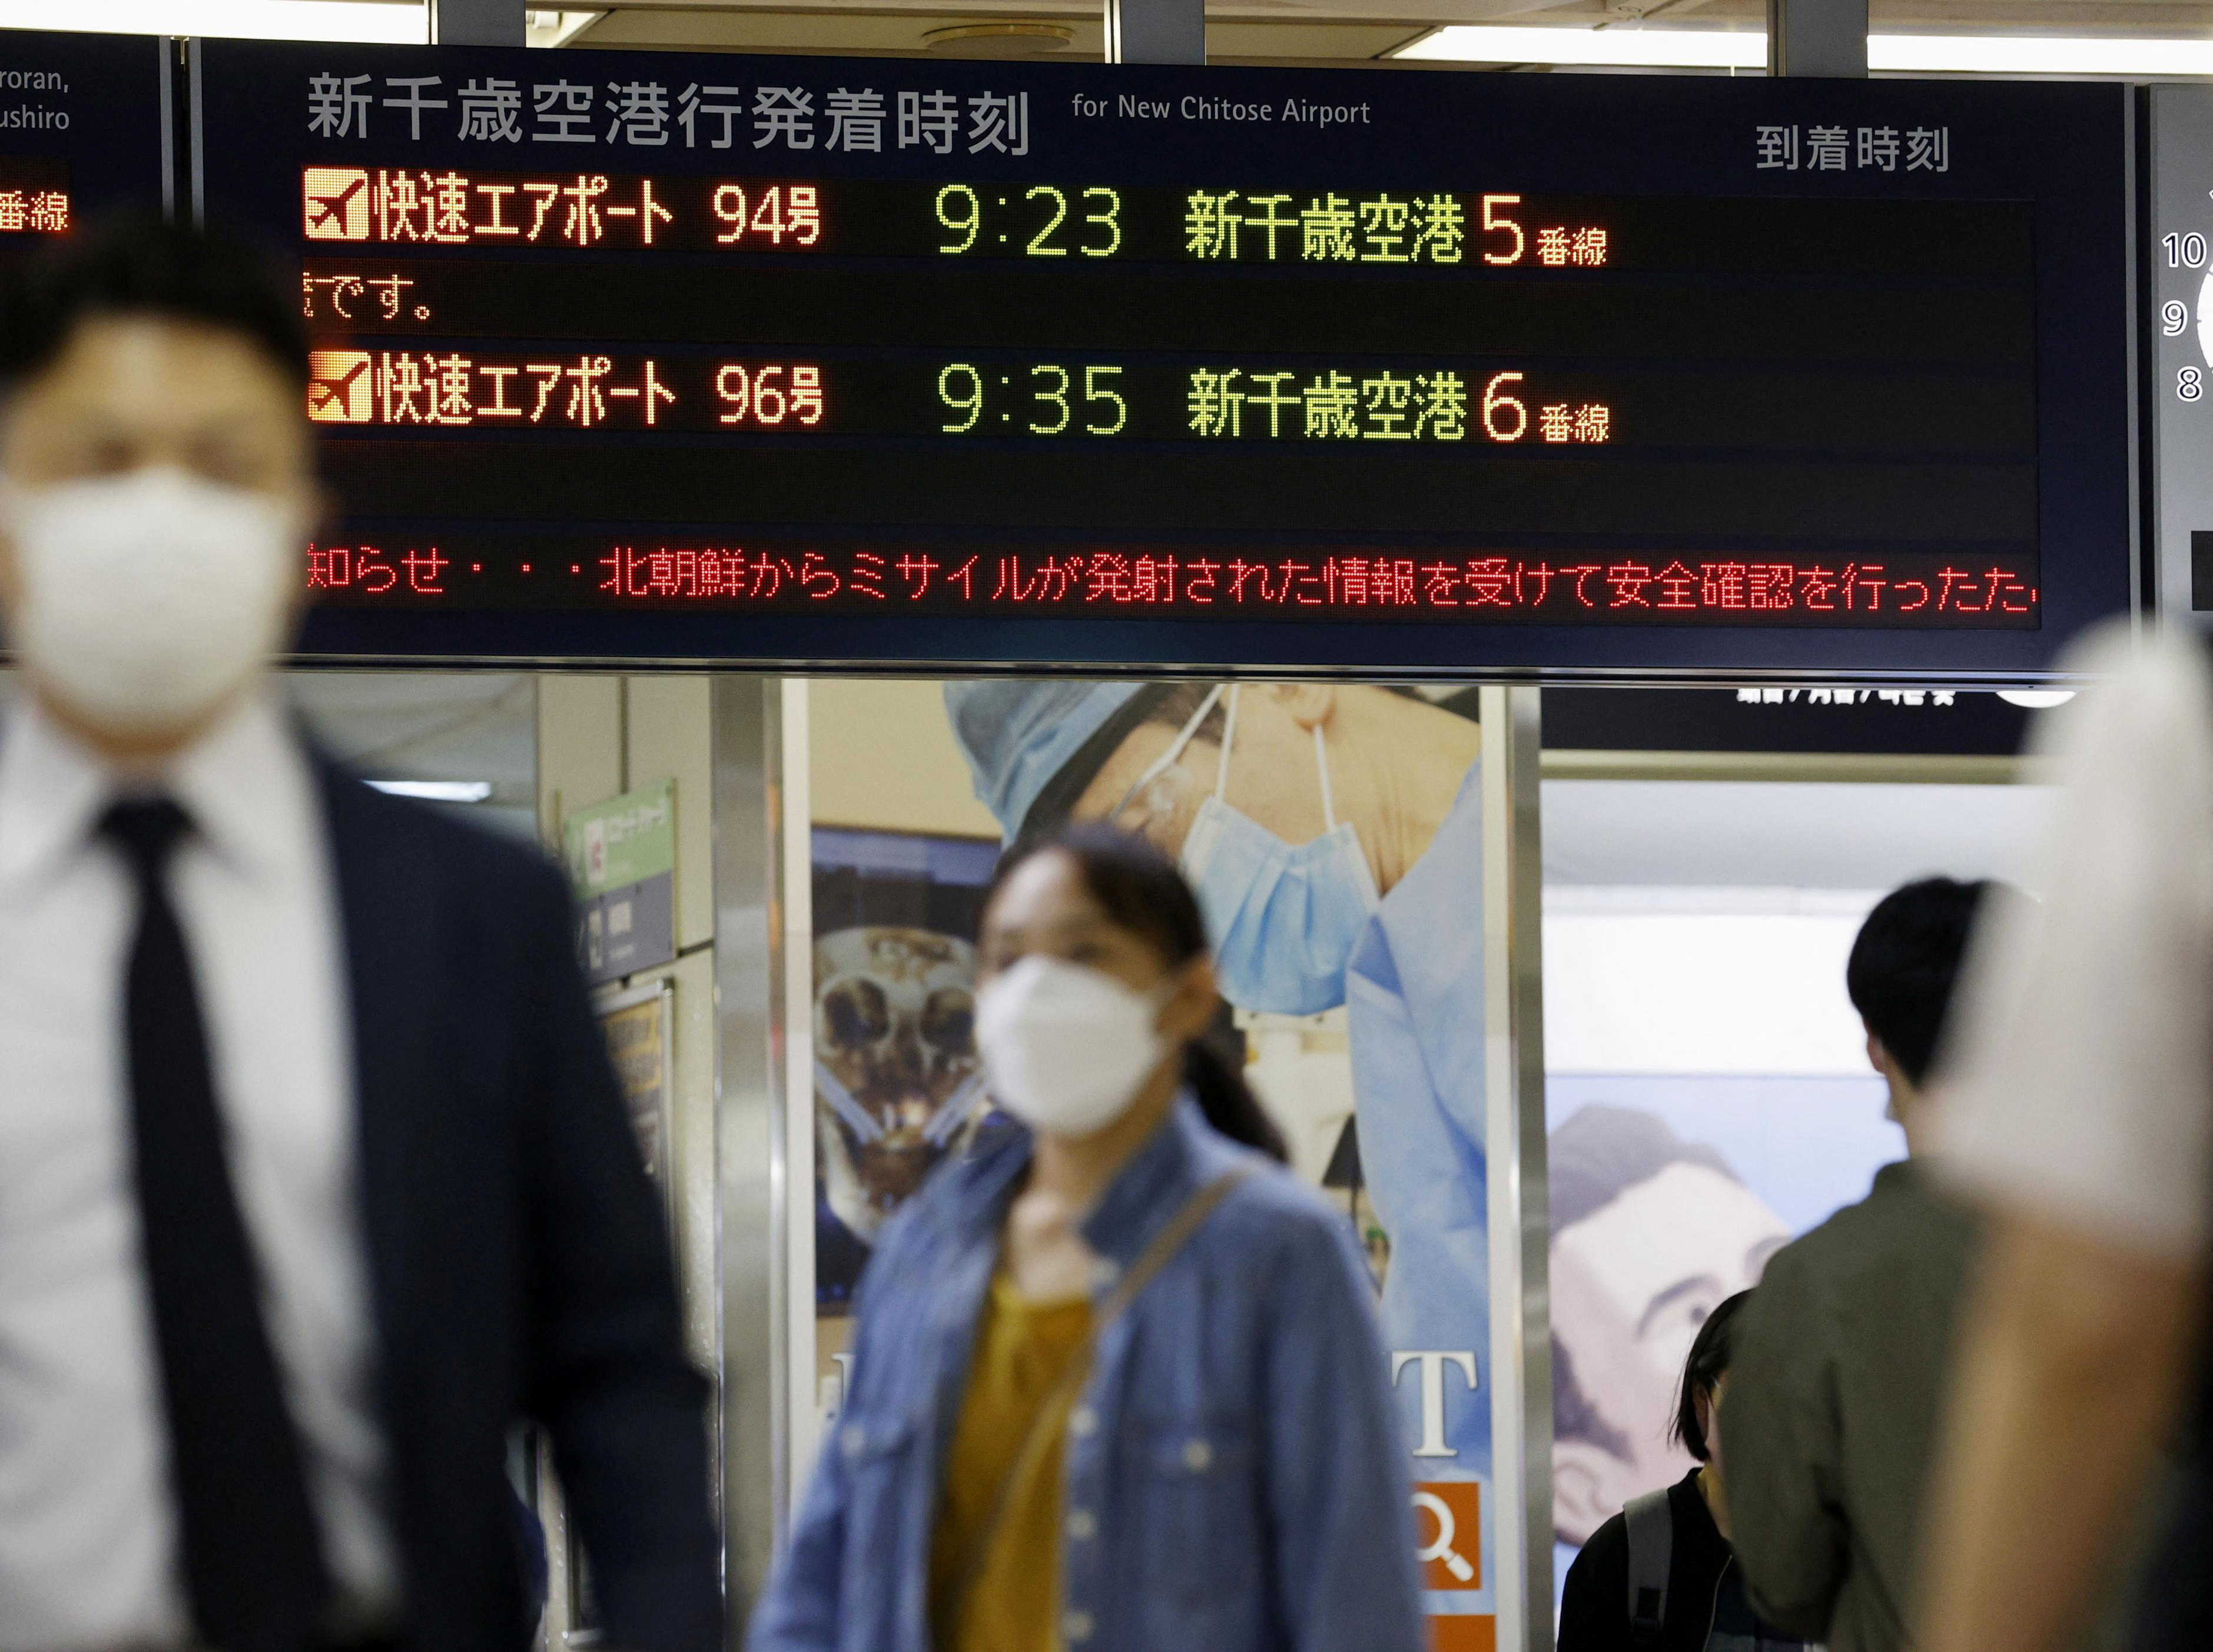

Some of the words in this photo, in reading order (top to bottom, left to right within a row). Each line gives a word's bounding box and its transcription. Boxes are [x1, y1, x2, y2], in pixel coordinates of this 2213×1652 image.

[0, 71, 68, 93] roran,
[308, 72, 1028, 155] 新千歳空港行発着時刻
[1072, 94, 1107, 117] for
[1119, 95, 1170, 118] New
[1181, 96, 1272, 121] Chitose
[1282, 98, 1371, 128] Airport
[1756, 125, 1949, 172] 到着時刻
[374, 170, 672, 246] 快速エアポート
[714, 185, 819, 244] 94号
[936, 184, 1120, 256] 9:23
[1185, 190, 1464, 263] 新千歳空港
[2162, 232, 2207, 268] 10
[303, 272, 430, 320] です。
[2162, 300, 2188, 336] 9
[377, 352, 675, 426] 快速エアポート
[717, 366, 822, 424] 96号
[938, 364, 1126, 434] 9:35
[1187, 368, 1467, 440] 新千歳空港
[2177, 366, 2203, 402] 8
